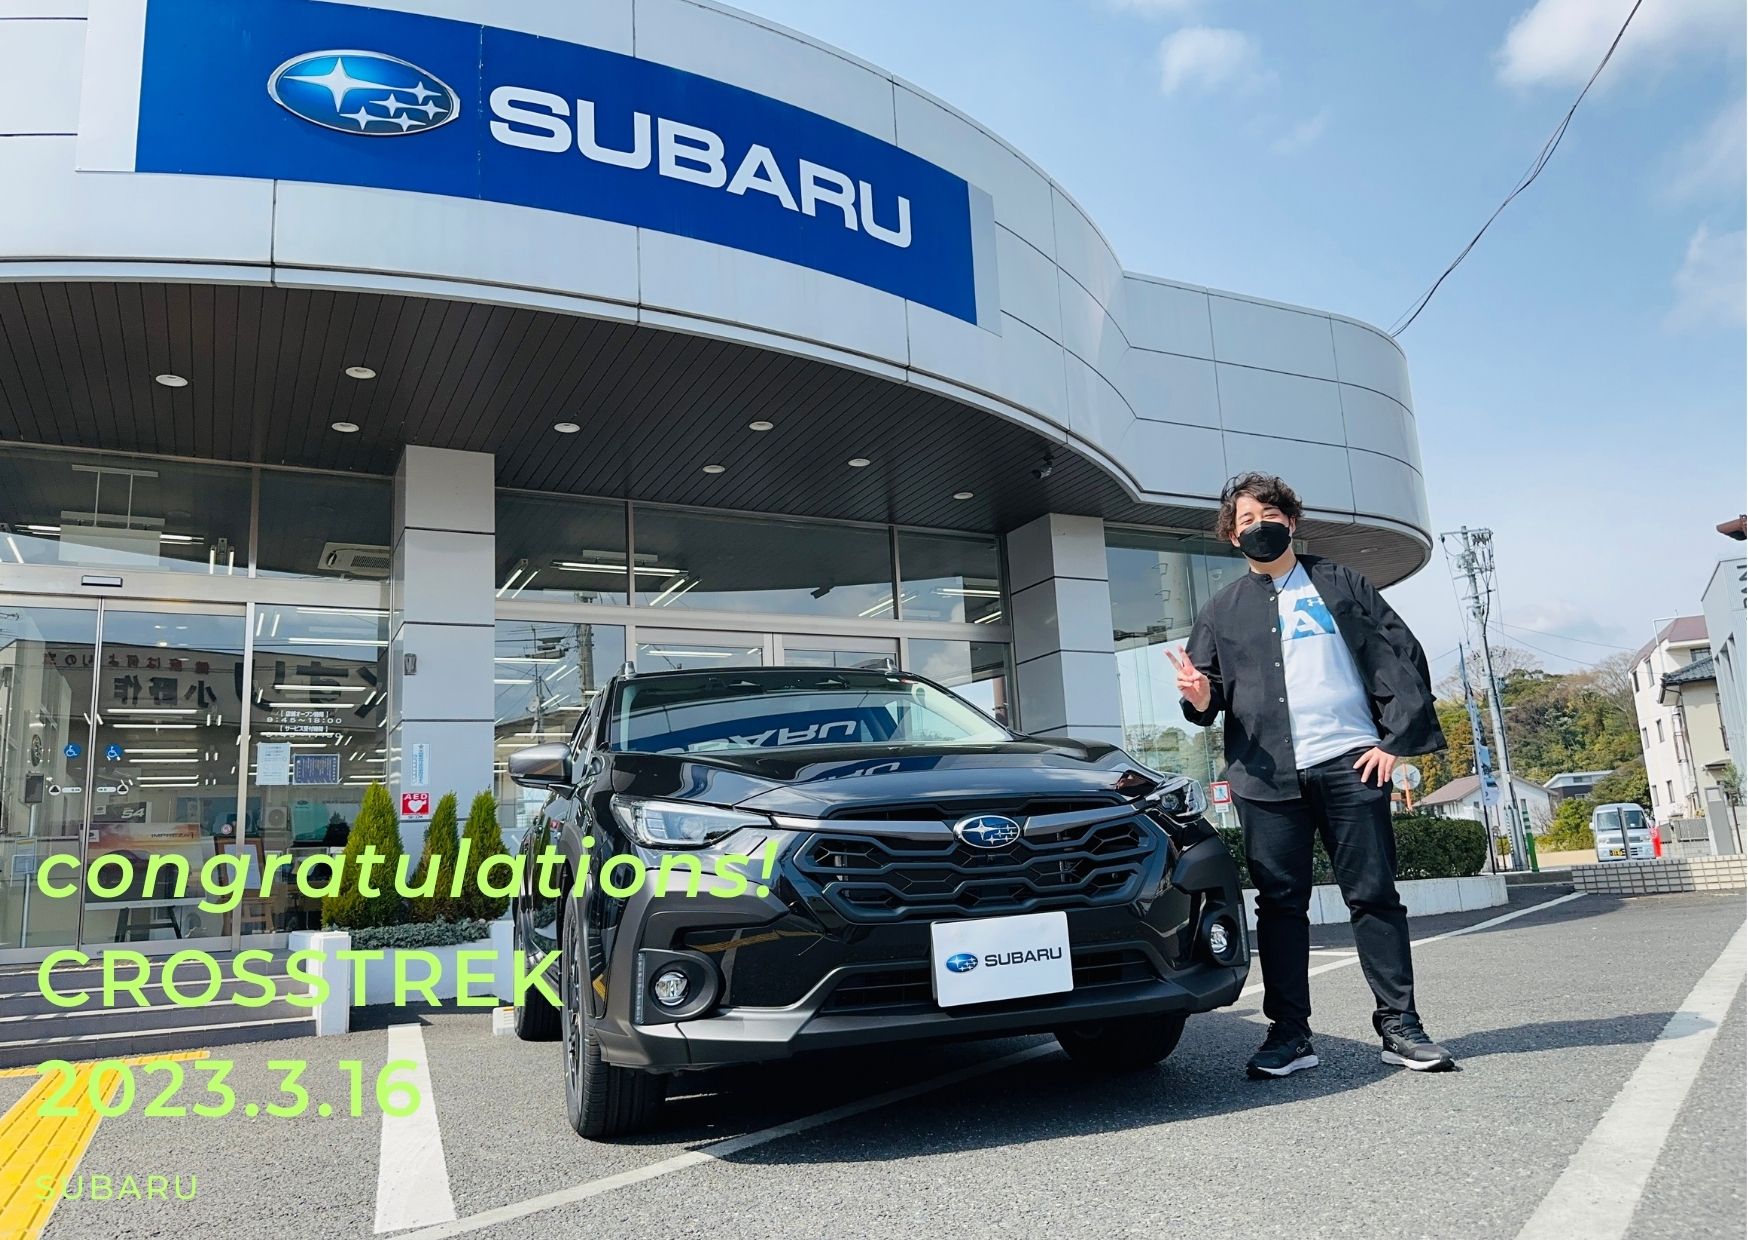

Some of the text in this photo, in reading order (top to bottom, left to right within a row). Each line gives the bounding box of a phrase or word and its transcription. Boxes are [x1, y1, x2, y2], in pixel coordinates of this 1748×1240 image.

[489, 86, 912, 248] SUBARU
[404, 793, 428, 801] AED
[984, 946, 1063, 968] SUBARU
